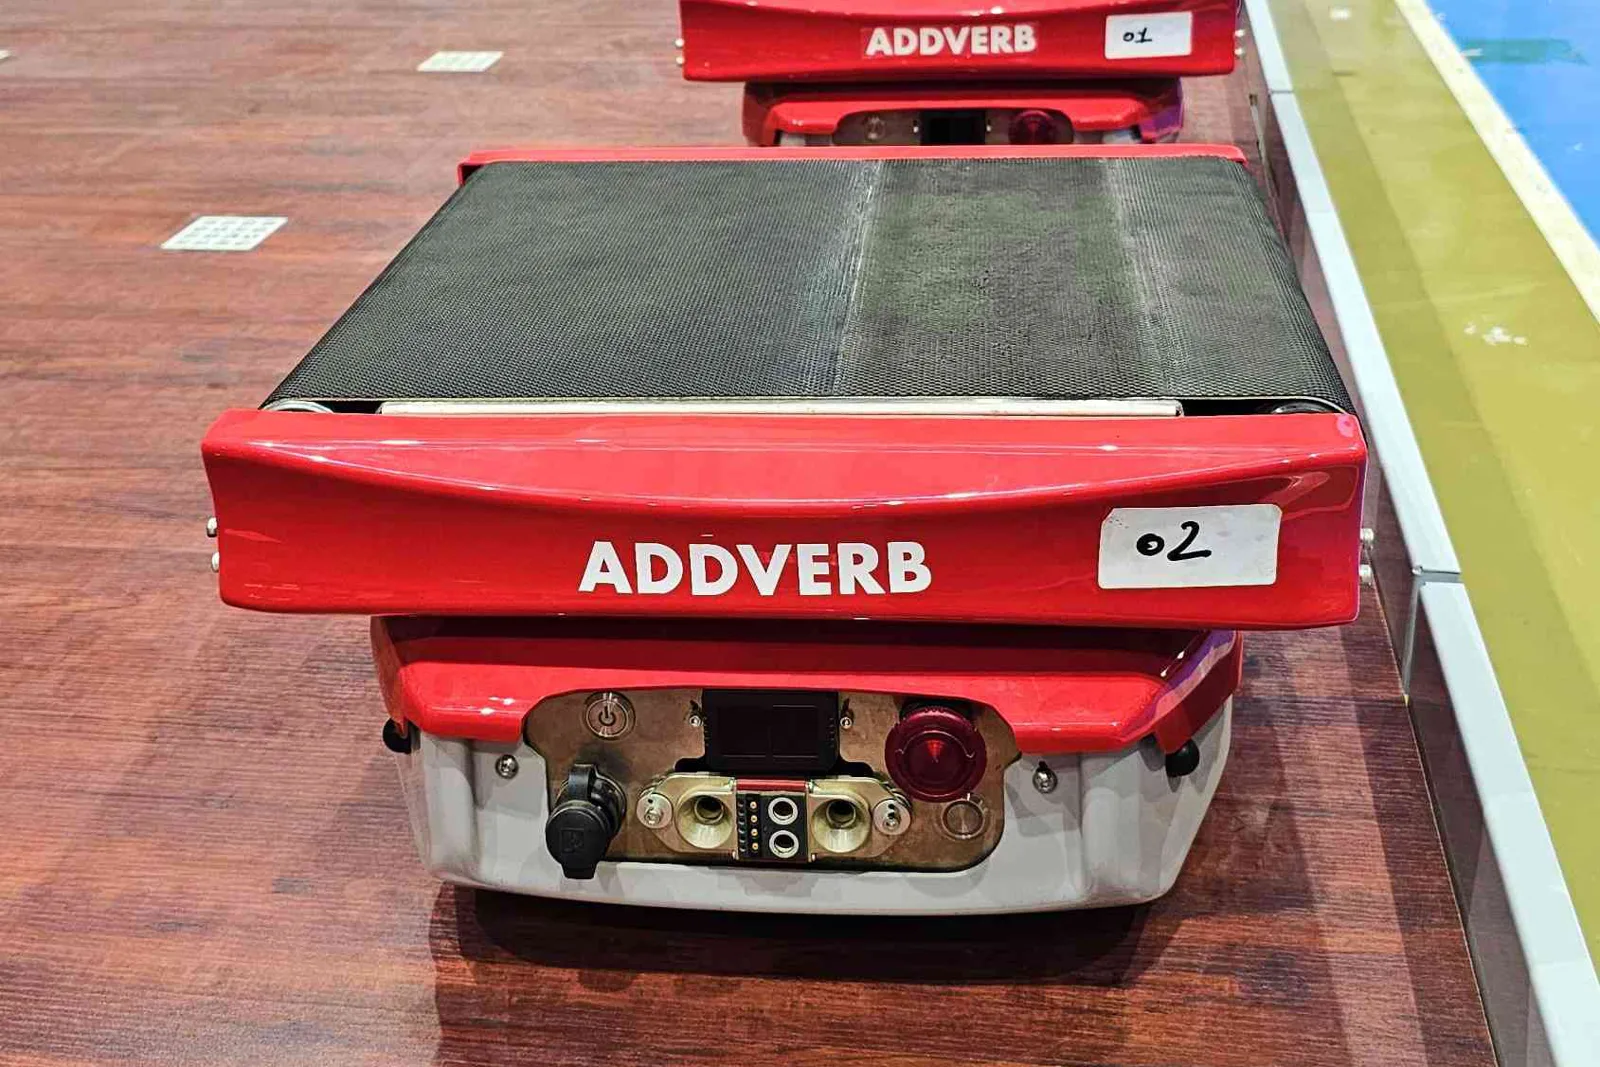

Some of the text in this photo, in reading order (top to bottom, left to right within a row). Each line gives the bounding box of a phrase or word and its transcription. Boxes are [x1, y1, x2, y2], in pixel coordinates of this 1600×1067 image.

[866, 25, 1036, 56] ADDVERB
[1122, 28, 1153, 44] 01
[1136, 520, 1212, 563] 02
[578, 540, 932, 596] ADDVERB
